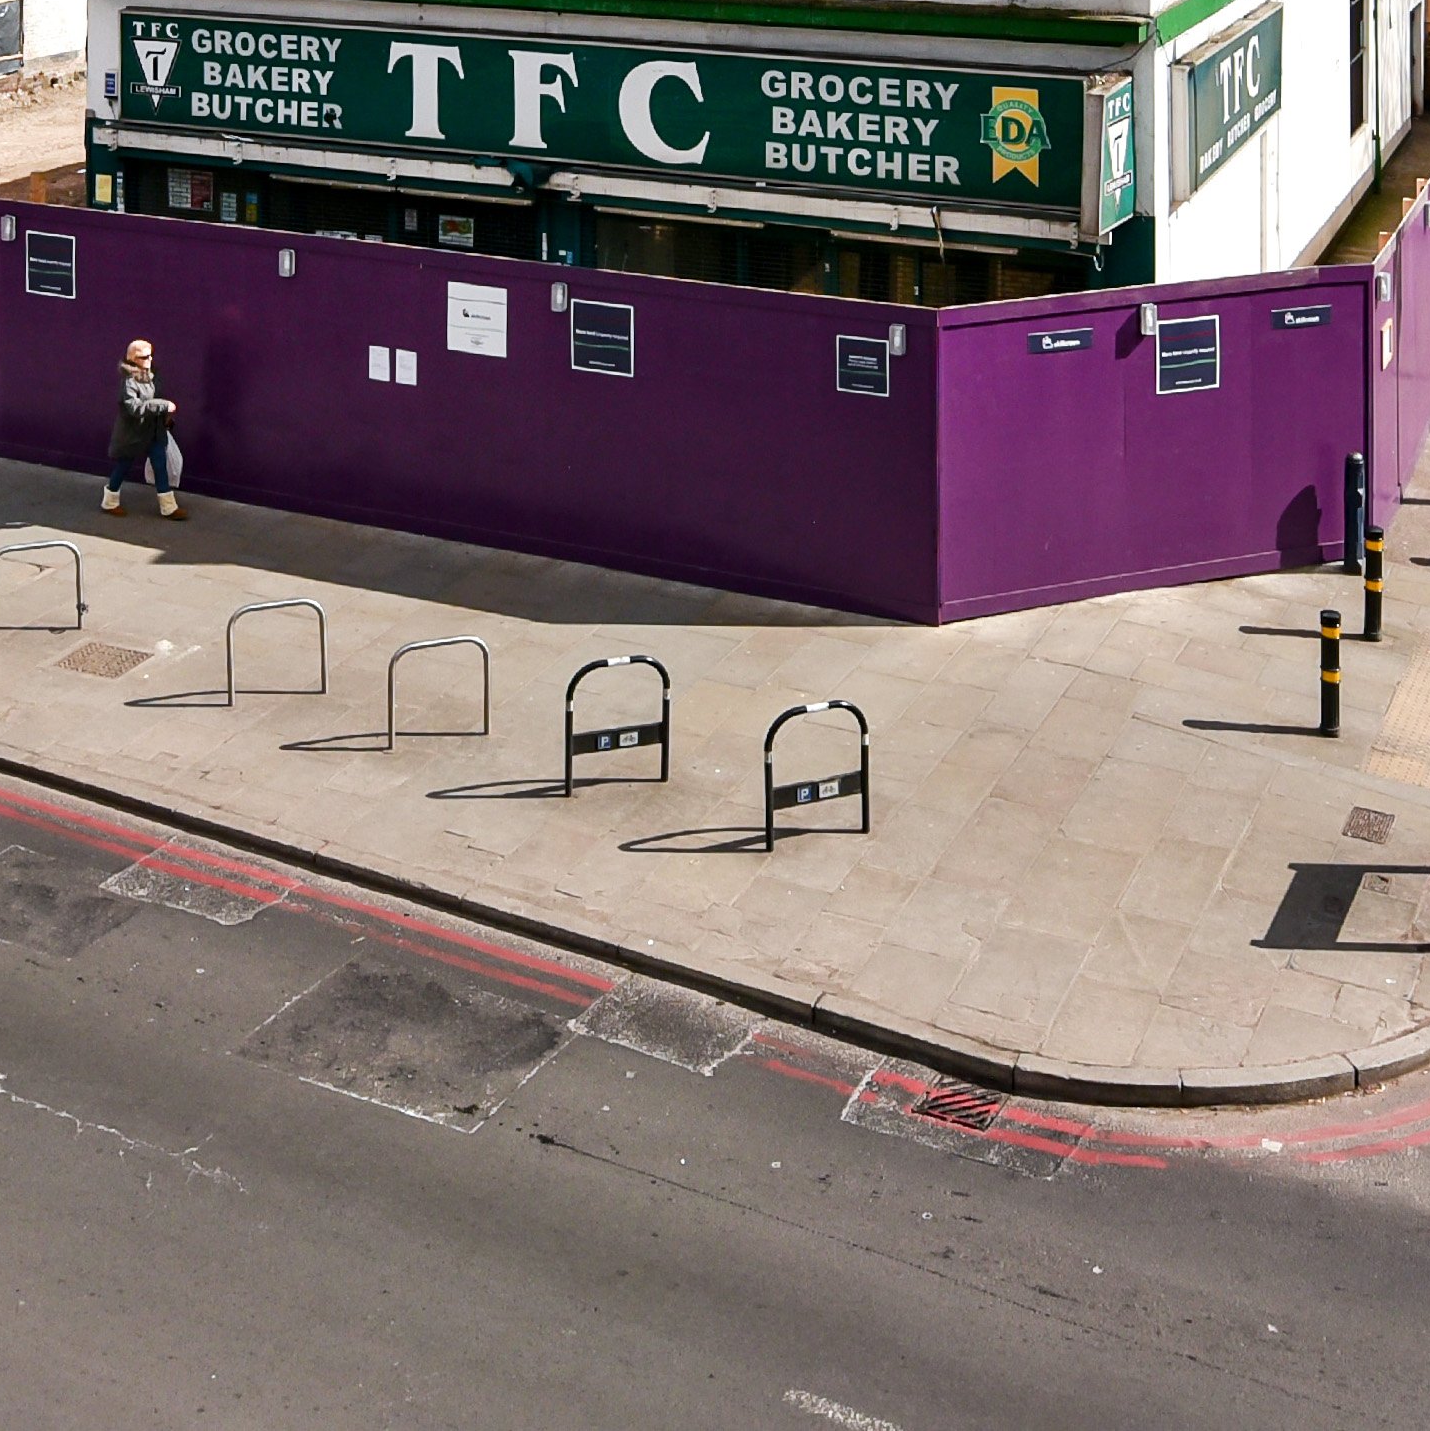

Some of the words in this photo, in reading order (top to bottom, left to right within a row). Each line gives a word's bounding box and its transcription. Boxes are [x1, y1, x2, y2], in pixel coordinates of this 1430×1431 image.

[191, 28, 342, 63] GROCERY
[135, 85, 177, 95] LEWISHAM
[203, 60, 335, 96] BAKERY
[760, 69, 960, 111] GROCERY
[1219, 34, 1261, 126] TFC
[191, 91, 344, 130] BUTCHER
[772, 105, 940, 147] BAKERY
[1107, 92, 1131, 120] TFC
[765, 141, 961, 186] BUTCHER
[1199, 137, 1224, 175] BAKERY
[1227, 112, 1252, 149] BUTCHER
